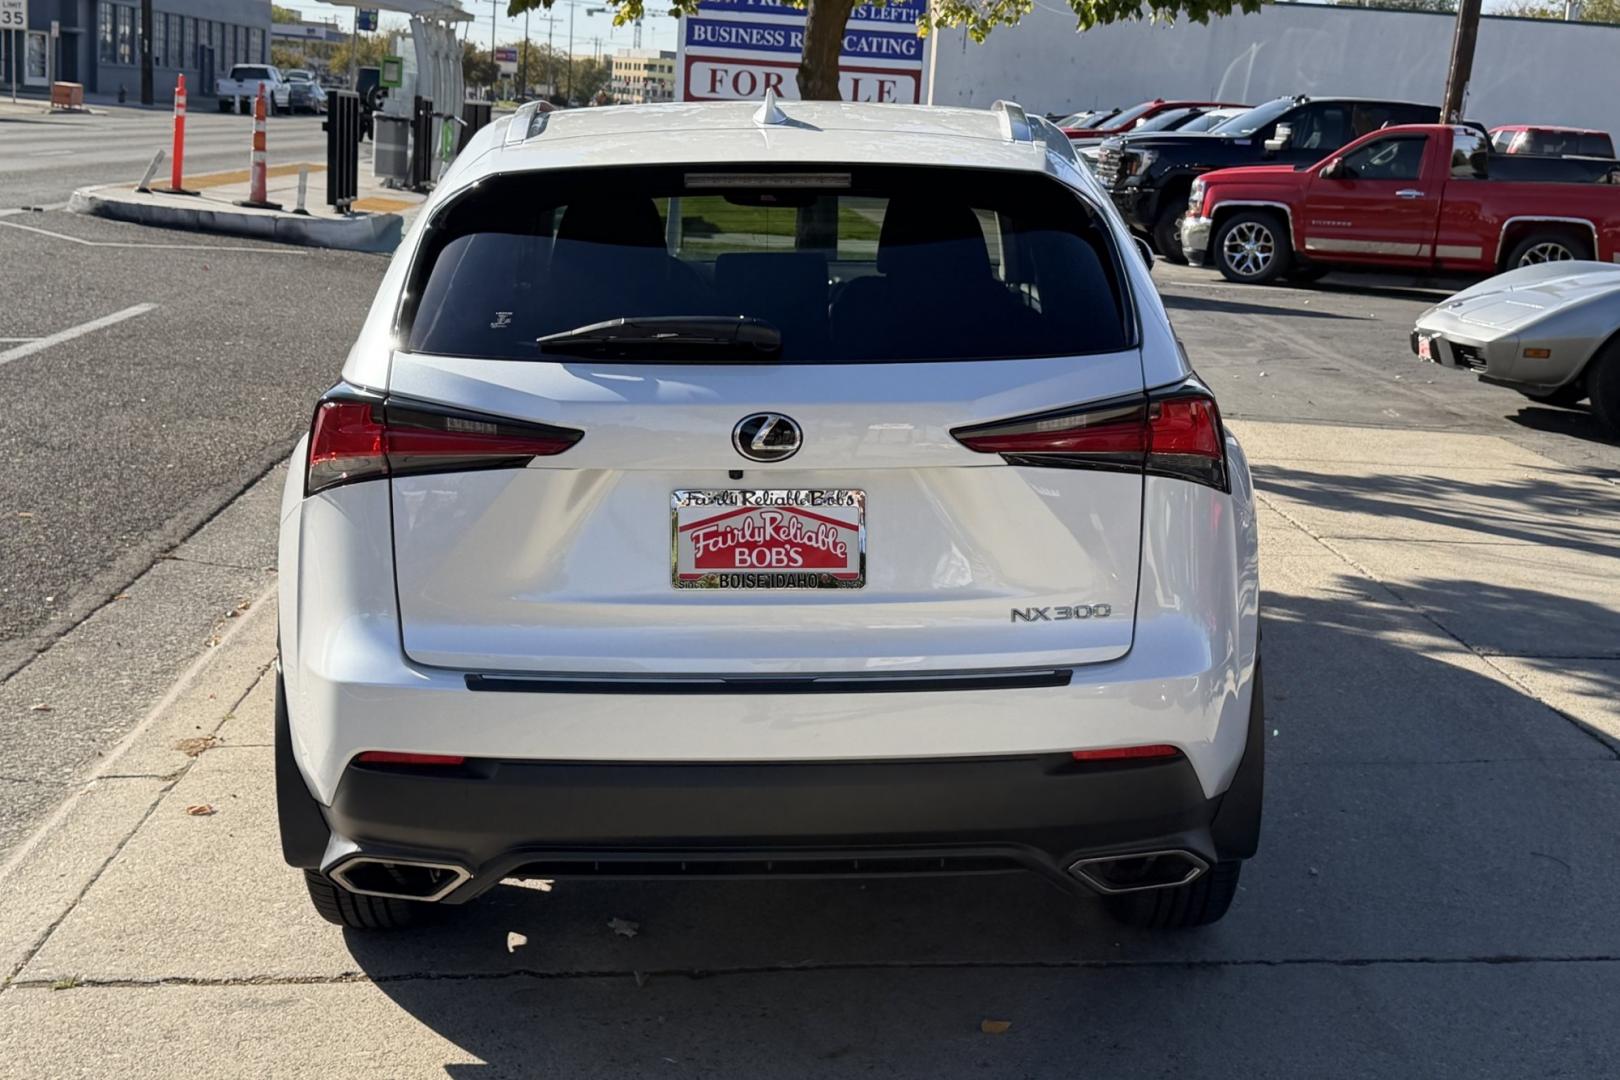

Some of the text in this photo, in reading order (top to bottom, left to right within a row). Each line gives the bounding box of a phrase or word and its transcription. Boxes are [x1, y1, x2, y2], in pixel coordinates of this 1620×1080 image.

[2, 11, 24, 25] 35
[693, 24, 916, 56] BUSINESS RCATING
[707, 68, 785, 98] FOR
[683, 490, 854, 506] Fairly Reliable Bob's
[691, 511, 848, 559] Fairly Reliable
[735, 543, 804, 568] BOB'S
[719, 573, 818, 589] BOISE IDAHO
